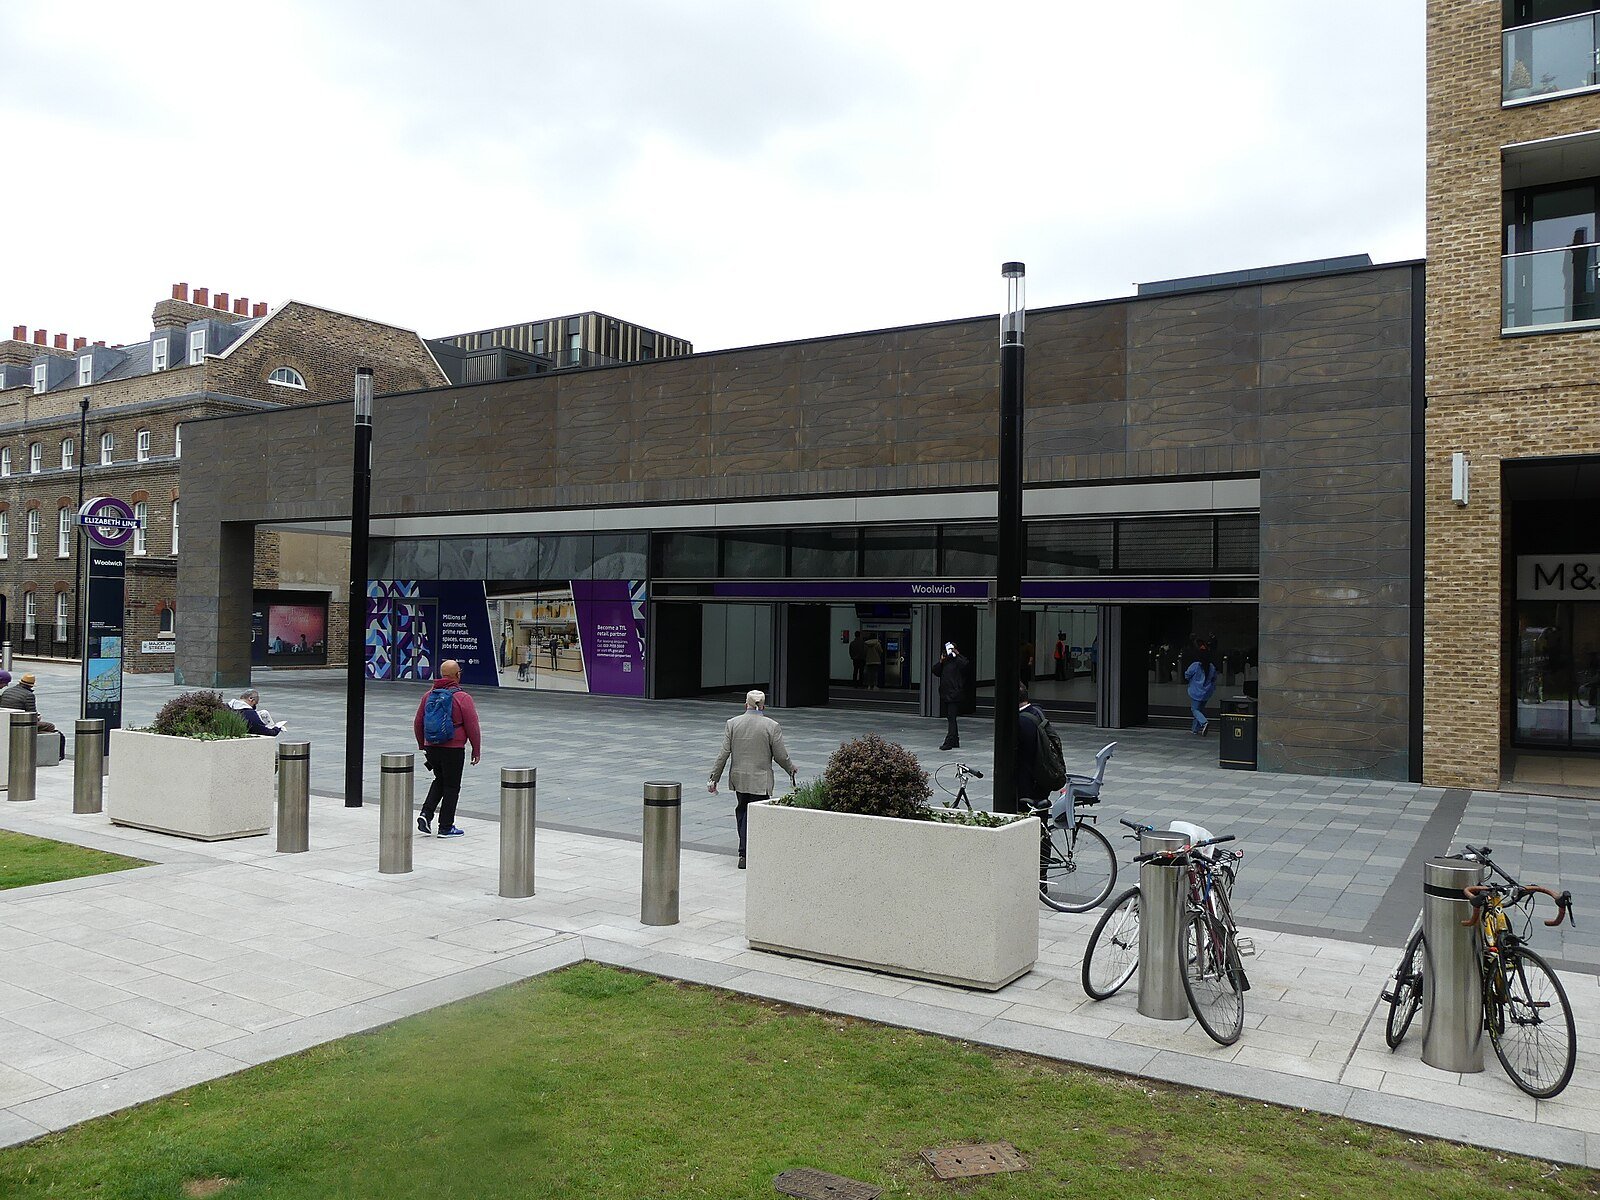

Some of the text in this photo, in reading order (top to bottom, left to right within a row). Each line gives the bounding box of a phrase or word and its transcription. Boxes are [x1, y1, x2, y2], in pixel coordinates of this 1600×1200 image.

[84, 516, 138, 528] ELIZABETH LINE
[94, 559, 123, 567] Woolwich
[1535, 563, 1600, 590] M&
[911, 584, 956, 593] Woolwich
